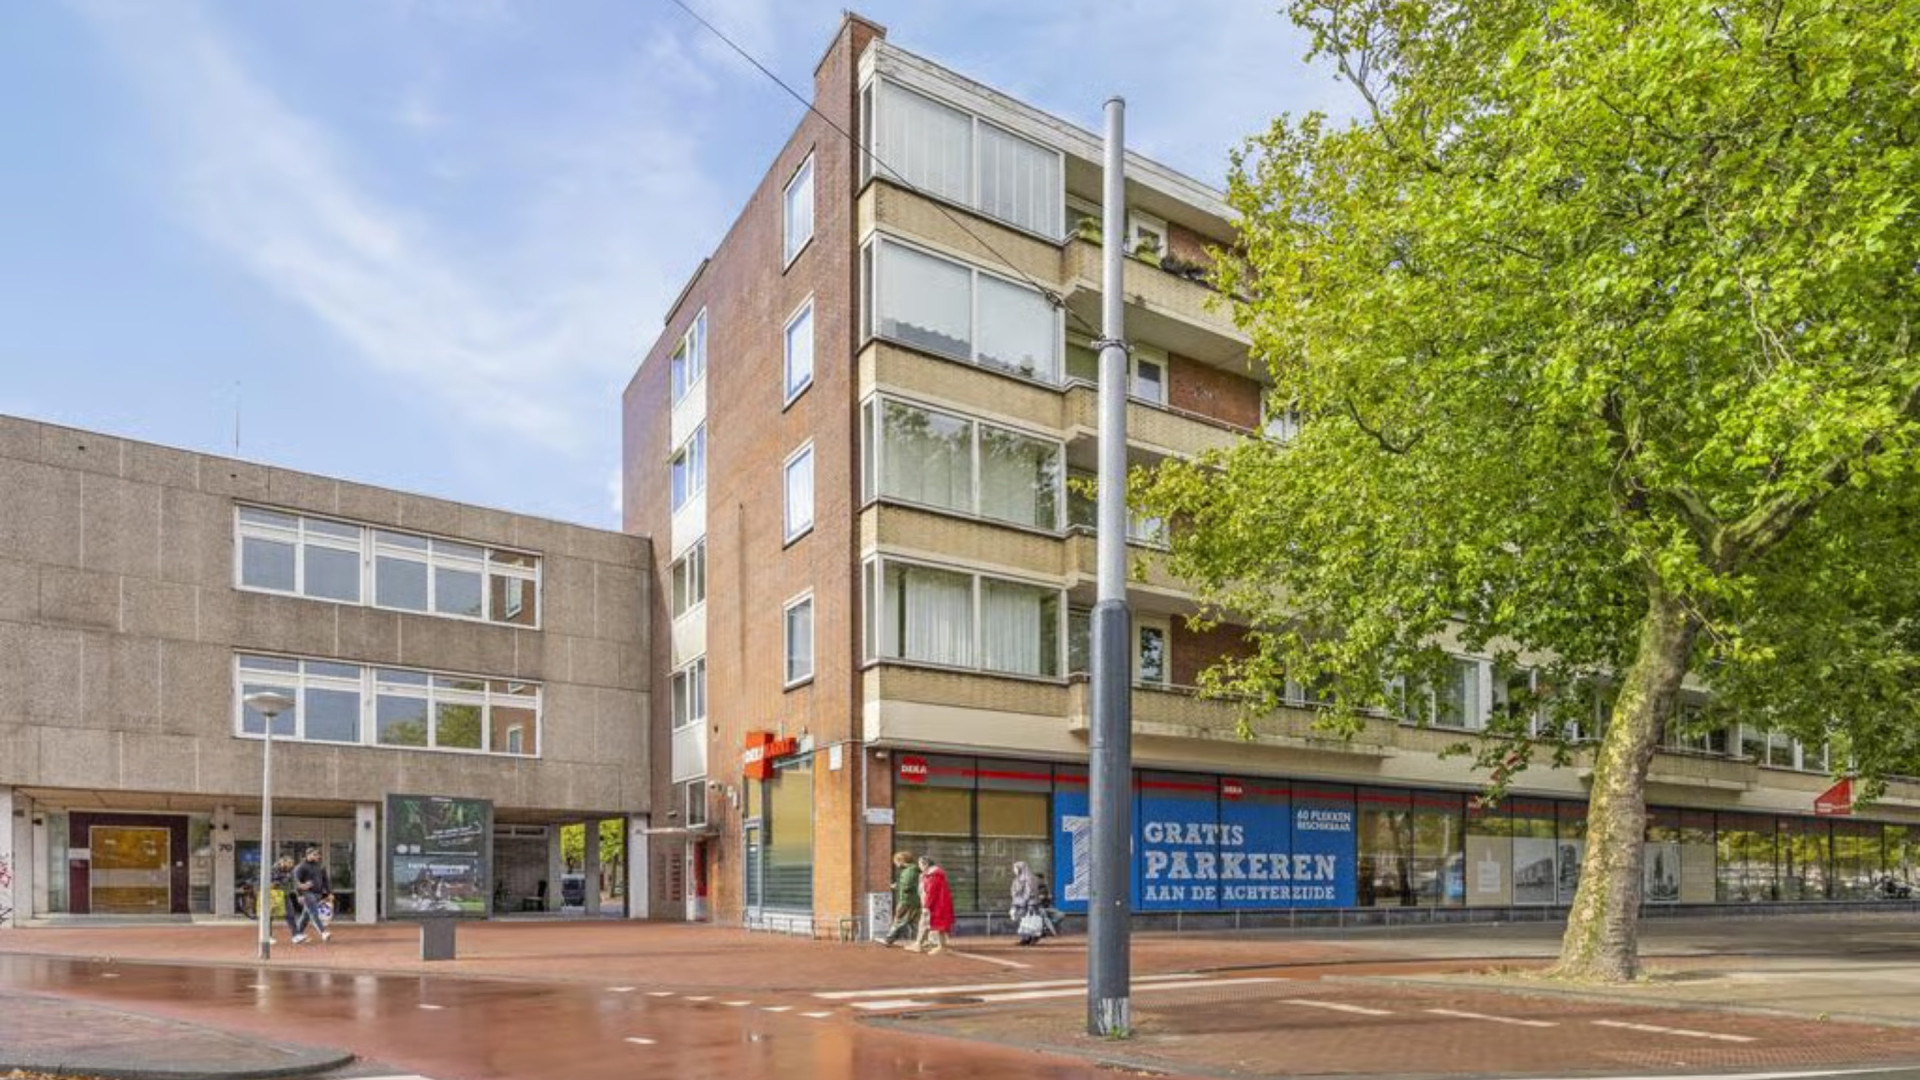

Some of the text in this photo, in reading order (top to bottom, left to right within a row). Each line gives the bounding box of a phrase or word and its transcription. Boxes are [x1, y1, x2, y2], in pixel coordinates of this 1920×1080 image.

[901, 765, 927, 774] DEKA
[1144, 822, 1244, 846] GRATIS
[1145, 851, 1336, 880] PARKEREN
[1145, 885, 1185, 900] AAN
[1192, 886, 1216, 900] DE
